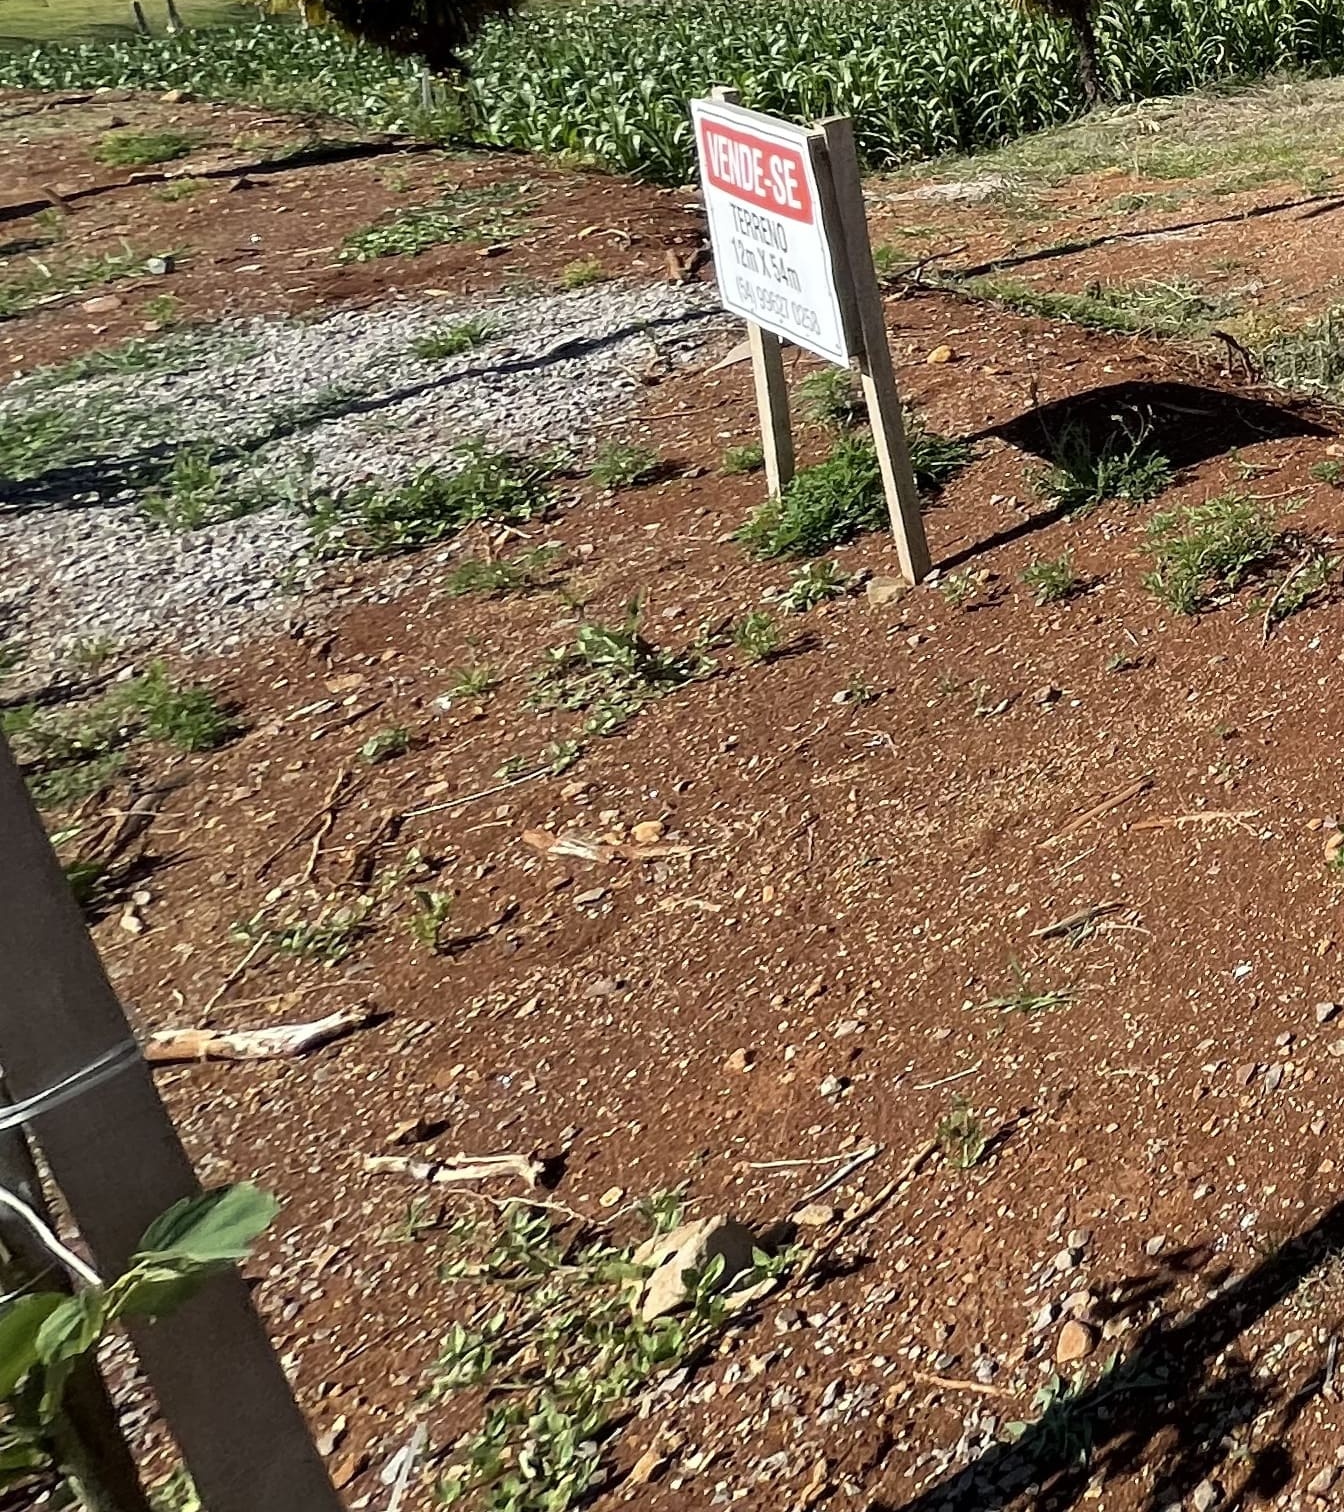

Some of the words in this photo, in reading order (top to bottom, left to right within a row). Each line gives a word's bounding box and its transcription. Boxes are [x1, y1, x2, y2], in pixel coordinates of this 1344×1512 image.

[706, 130, 803, 210] VENDE-SE
[728, 202, 788, 253] TERRENO
[731, 236, 759, 273] 12m
[770, 253, 802, 293] 54m
